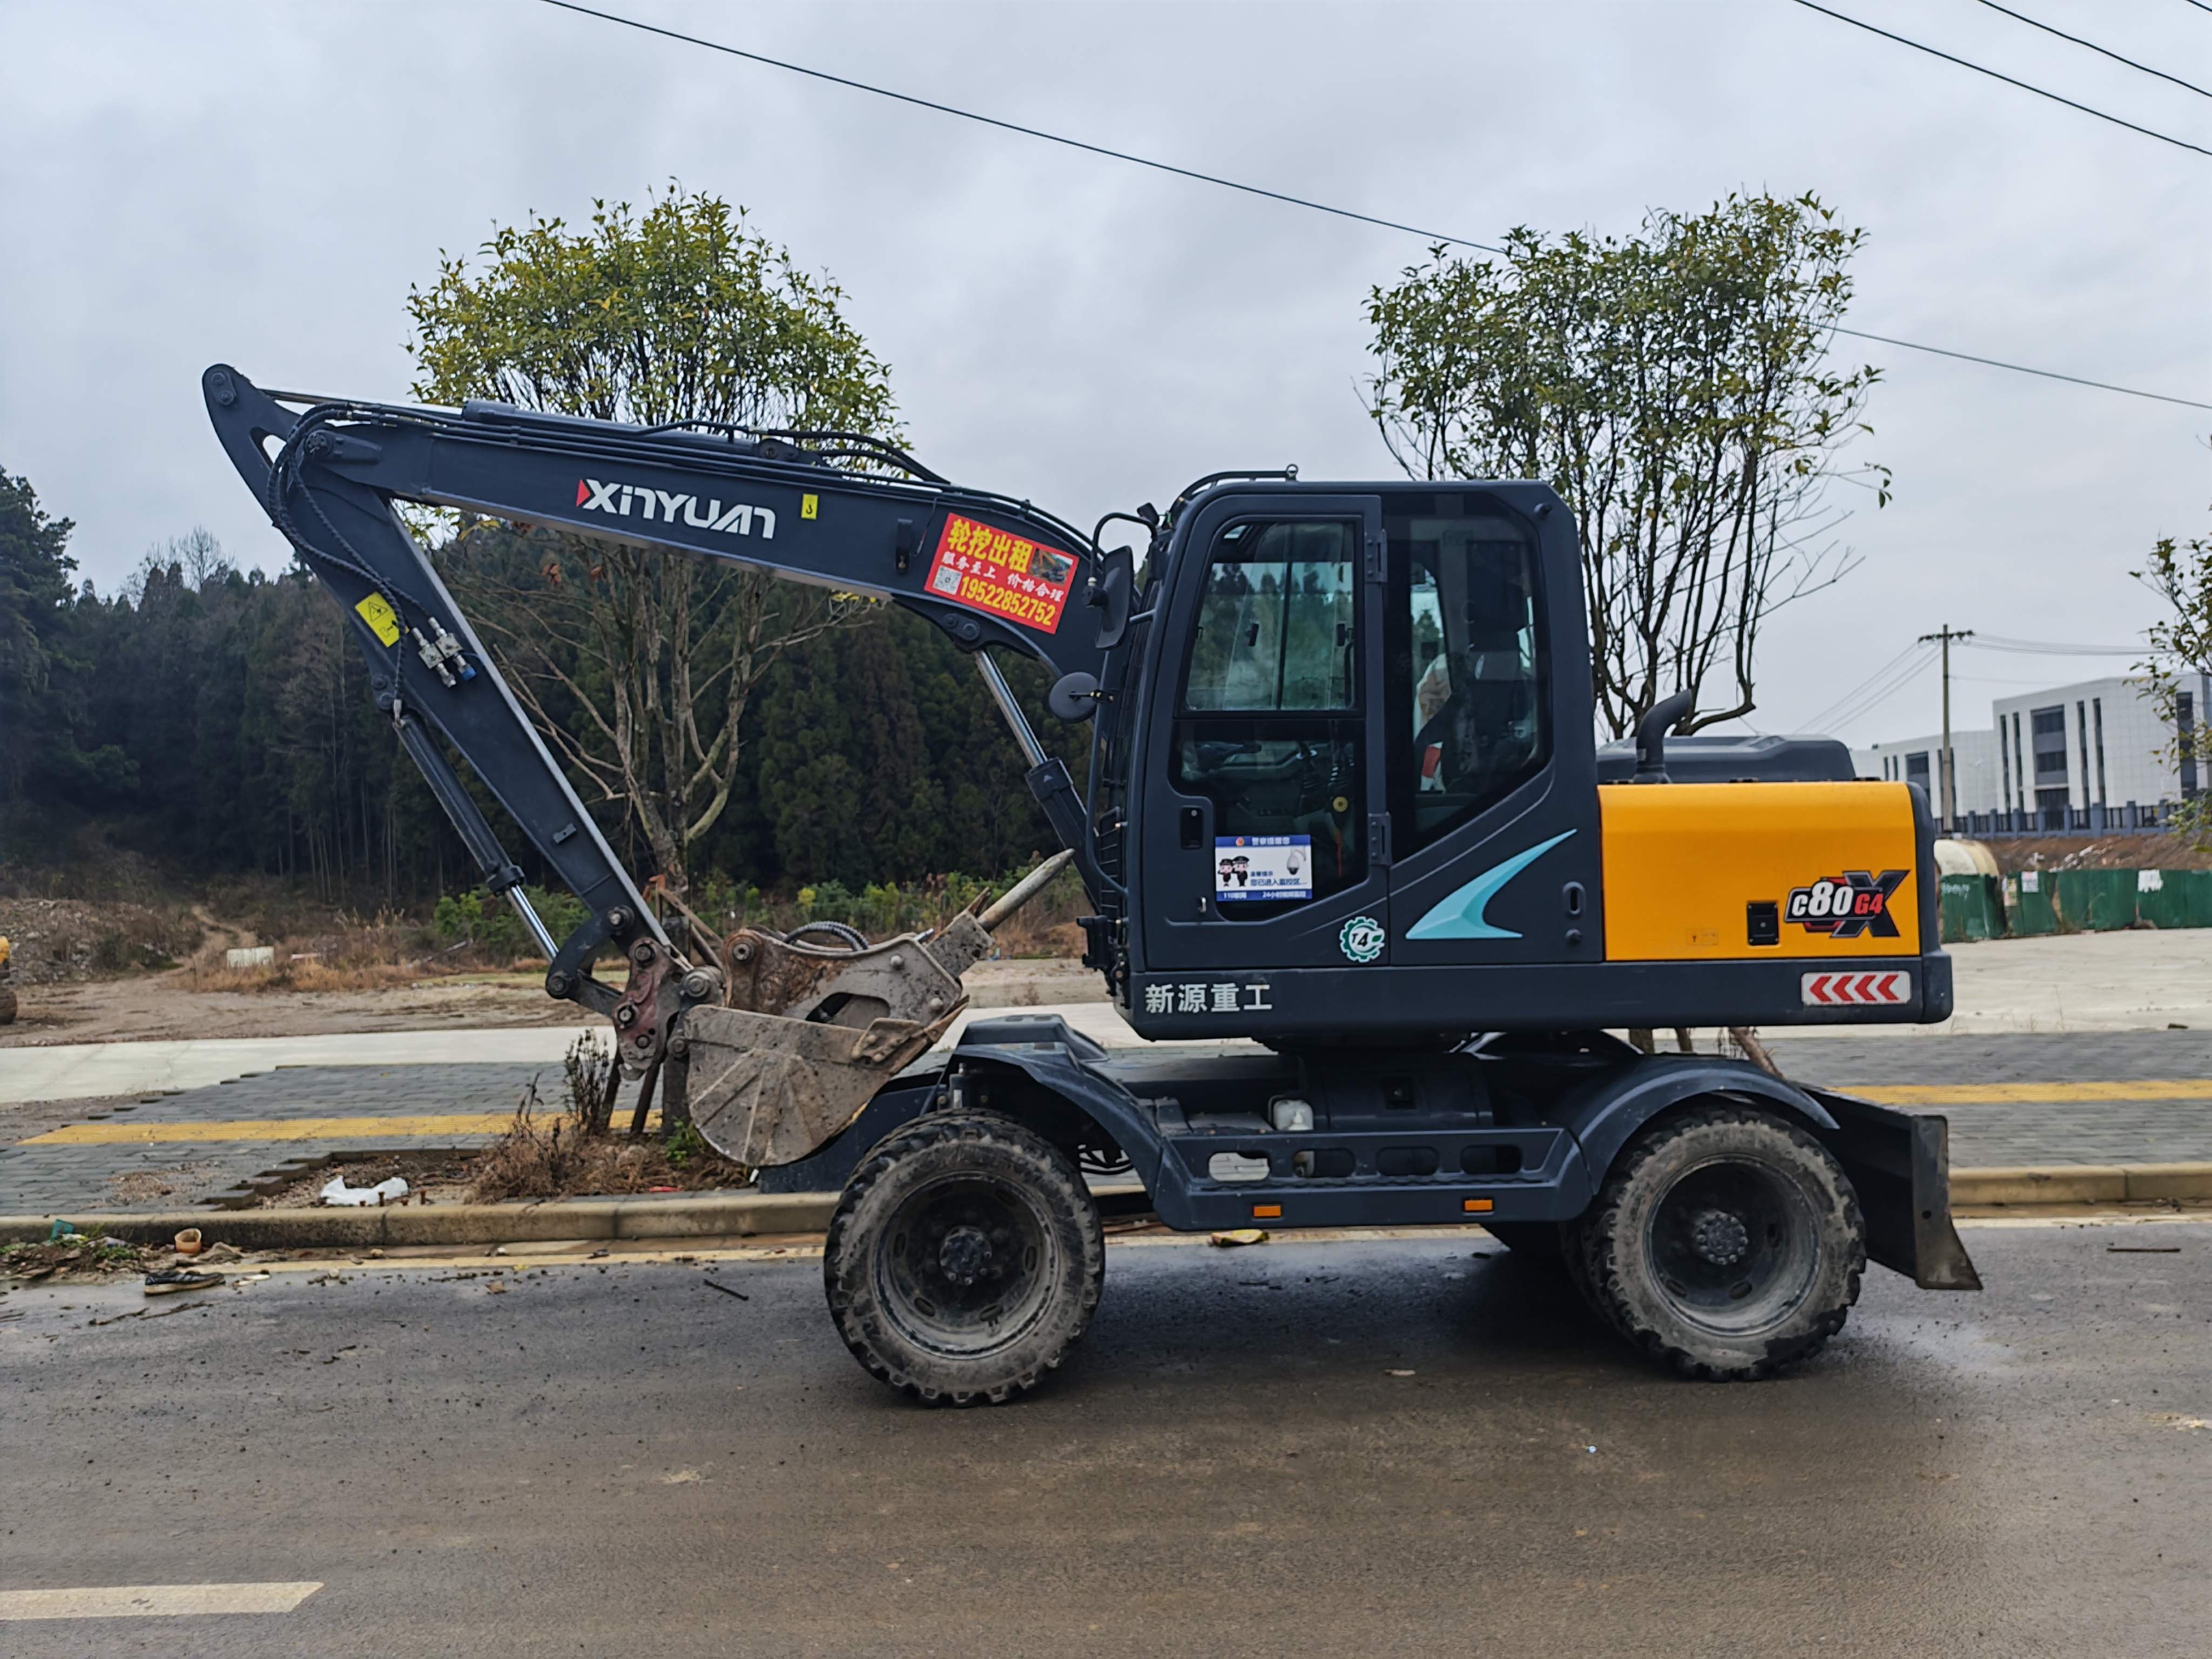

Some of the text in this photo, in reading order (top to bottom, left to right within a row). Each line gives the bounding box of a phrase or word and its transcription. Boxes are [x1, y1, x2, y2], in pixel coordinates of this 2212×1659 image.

[948, 518, 1033, 574] 轮挖出租
[941, 551, 1064, 602] 服务至上 价格合理
[960, 576, 1056, 626] 19522852752
[1351, 932, 1370, 948] T4
[1144, 982, 1273, 1014] 新源重工
